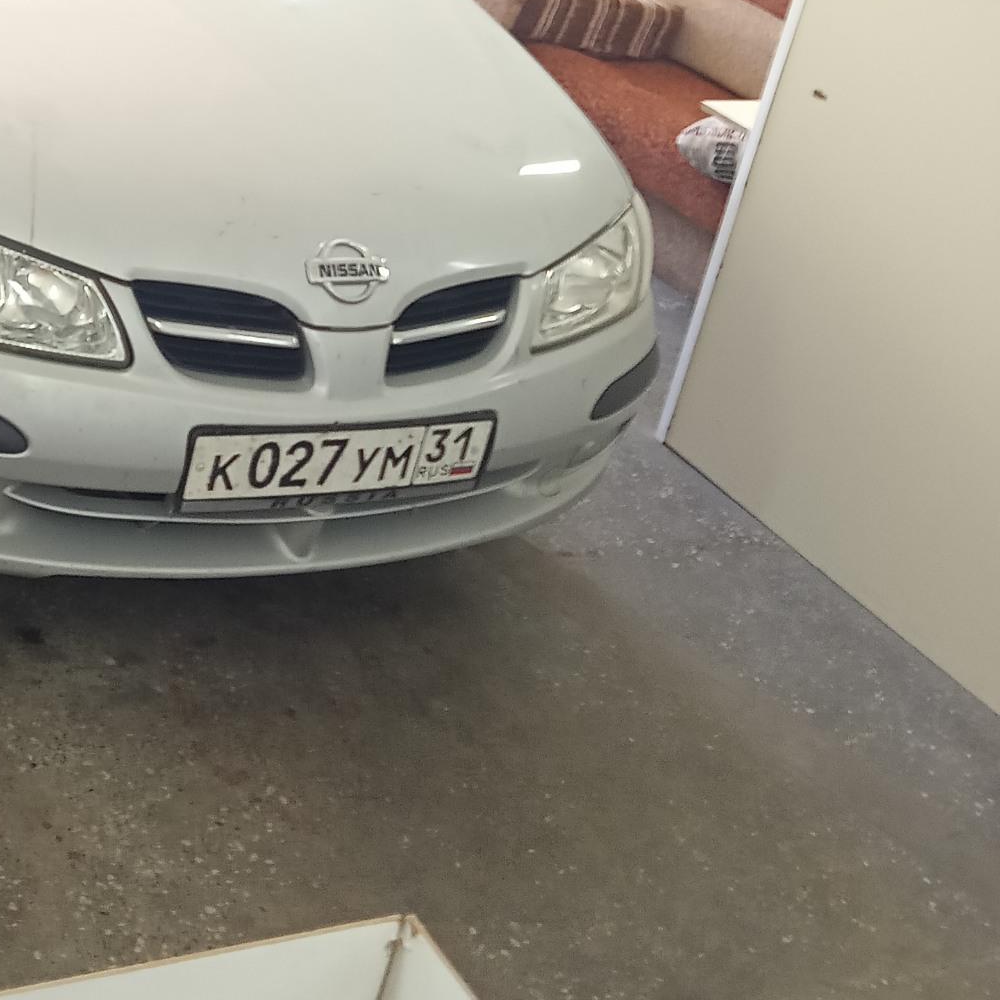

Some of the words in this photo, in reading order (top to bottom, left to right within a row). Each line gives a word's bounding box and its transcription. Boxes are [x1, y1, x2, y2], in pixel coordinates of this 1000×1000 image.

[319, 263, 380, 277] NISSAN
[426, 426, 474, 463] 31
[418, 465, 450, 481] RUS
